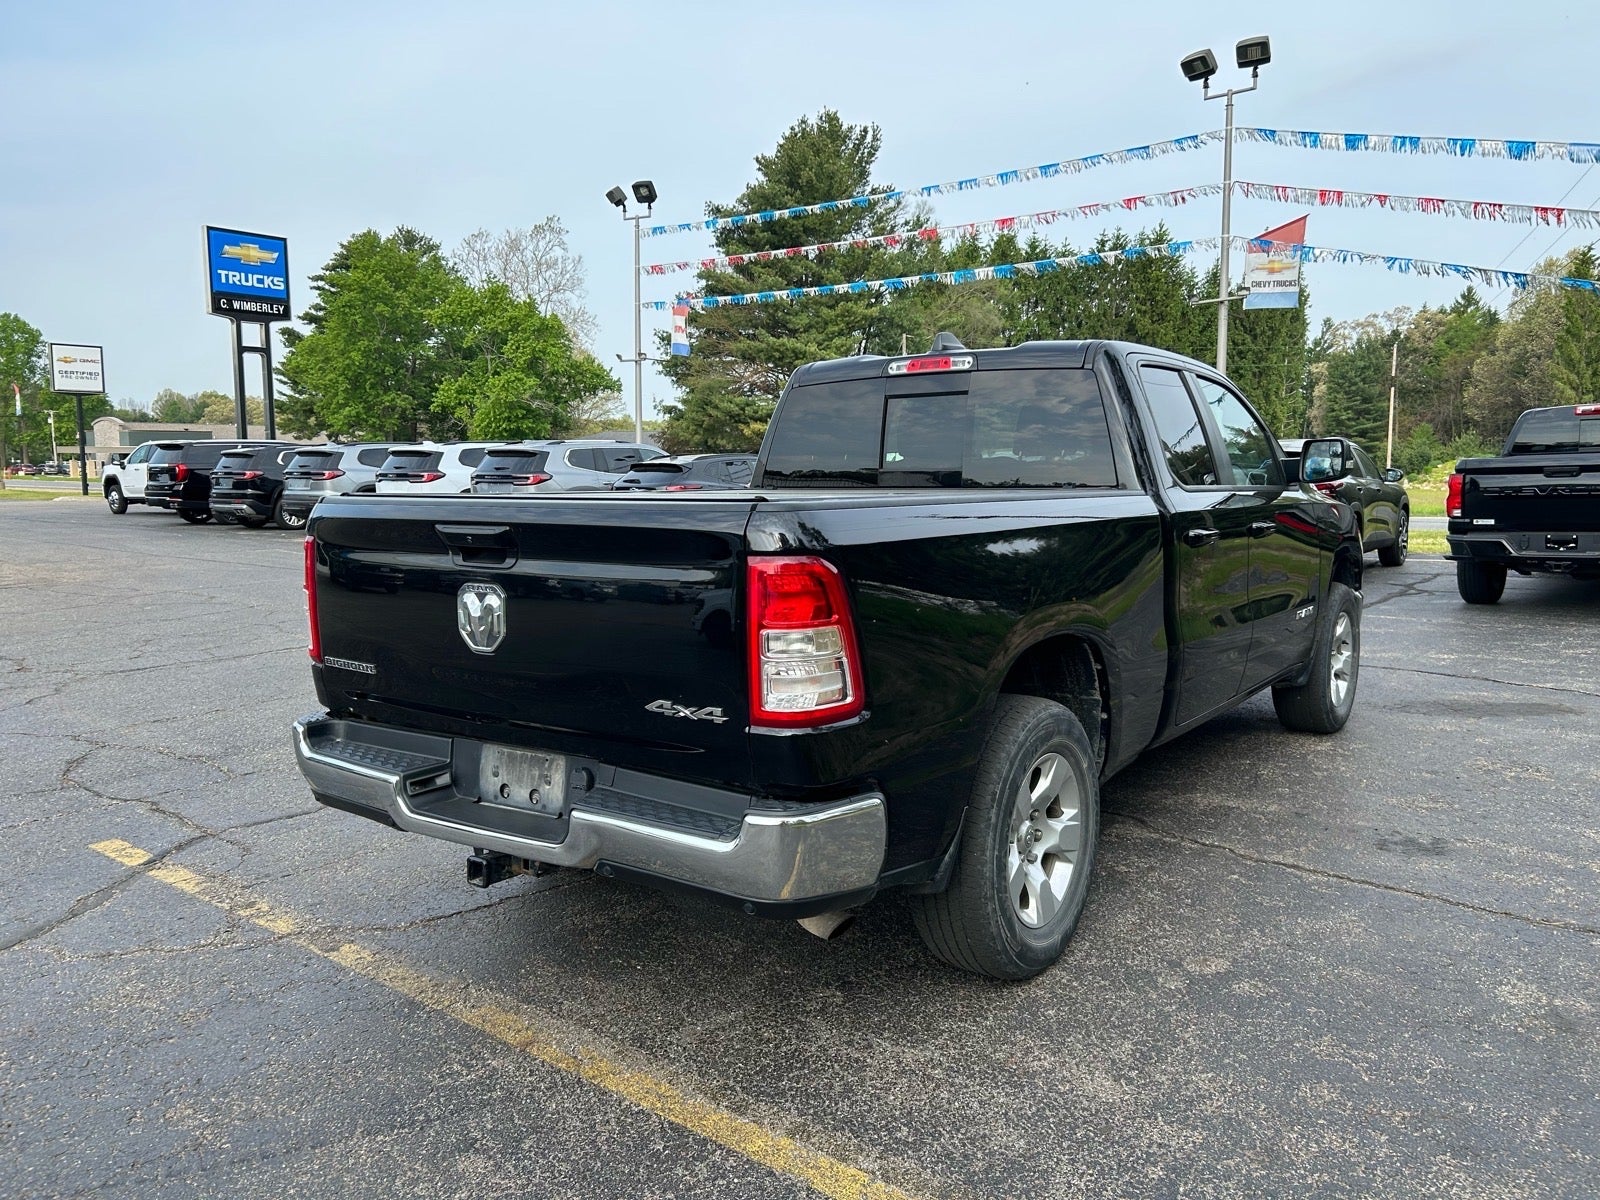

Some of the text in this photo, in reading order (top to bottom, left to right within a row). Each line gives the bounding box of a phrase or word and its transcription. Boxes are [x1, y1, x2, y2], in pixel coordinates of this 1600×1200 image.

[217, 269, 285, 290] TRUCKS
[1251, 280, 1271, 288] CHEVY
[220, 298, 285, 314] C. WIMBERLEY
